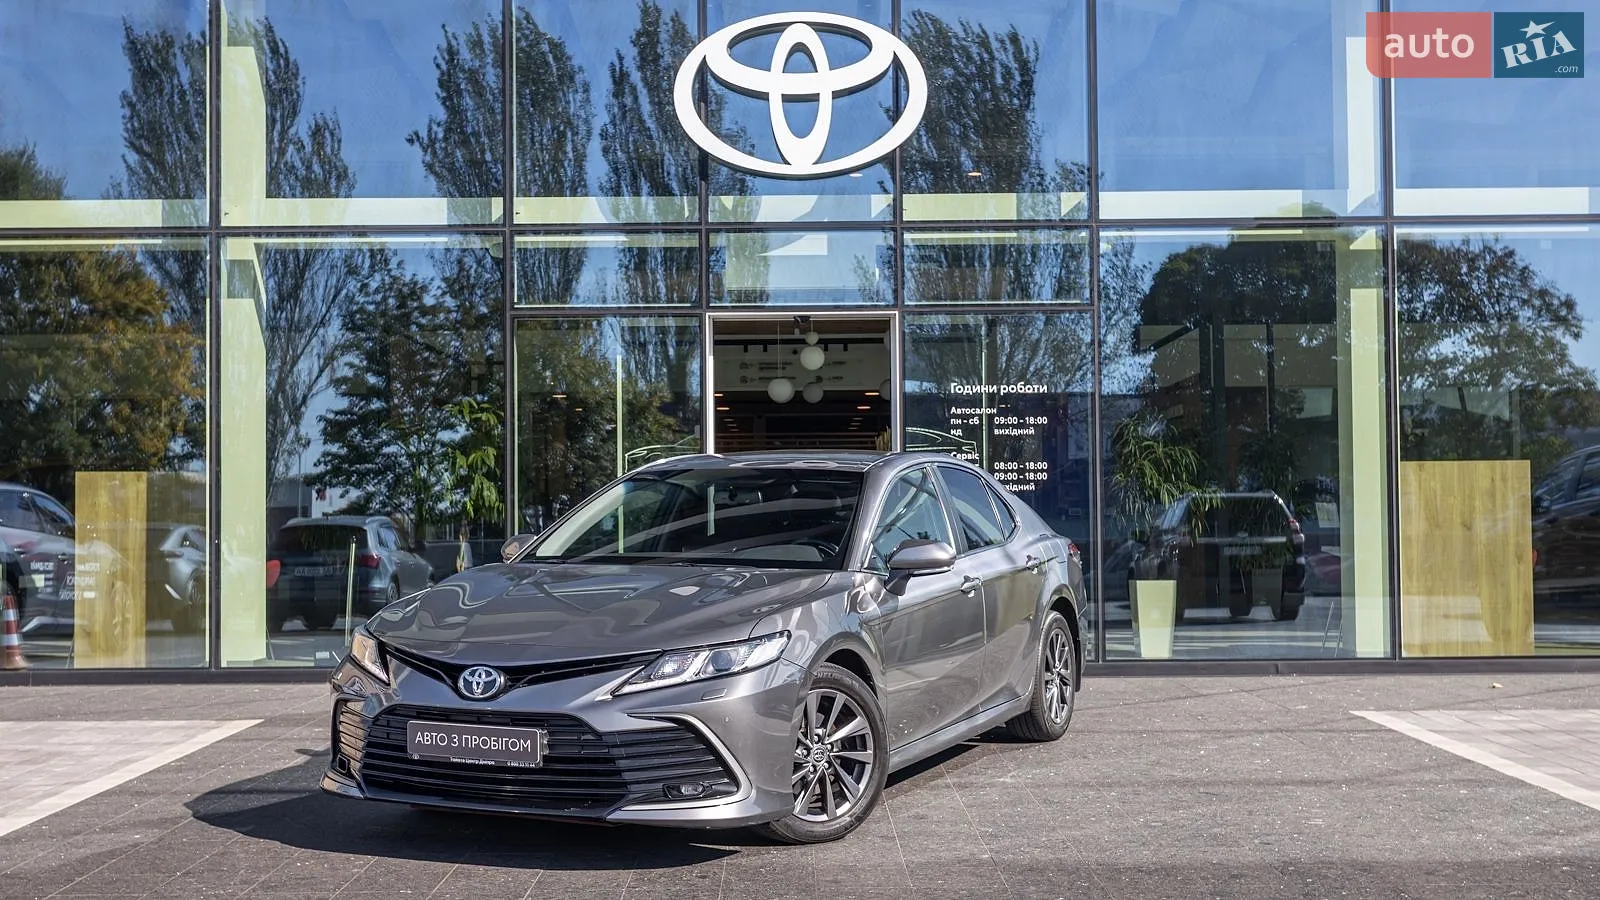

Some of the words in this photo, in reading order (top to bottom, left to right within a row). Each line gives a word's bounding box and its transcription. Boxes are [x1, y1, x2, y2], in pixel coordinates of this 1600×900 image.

[950, 383, 997, 395] Години
[1000, 382, 1048, 395] роботи
[969, 417, 979, 425] сб
[994, 417, 1018, 425] 09:00
[1025, 417, 1048, 425] 18:00
[994, 428, 1035, 436] вихідний
[950, 452, 980, 460] Сервіс
[994, 461, 1018, 470] 08:00
[1025, 461, 1048, 470] 18:00
[994, 472, 1018, 480] 09:00
[1025, 472, 1048, 480] 18:00
[1005, 482, 1035, 492] хідний
[415, 731, 448, 746] АВТО
[451, 734, 459, 747] З
[462, 735, 531, 753] ПРОБІГОМ
